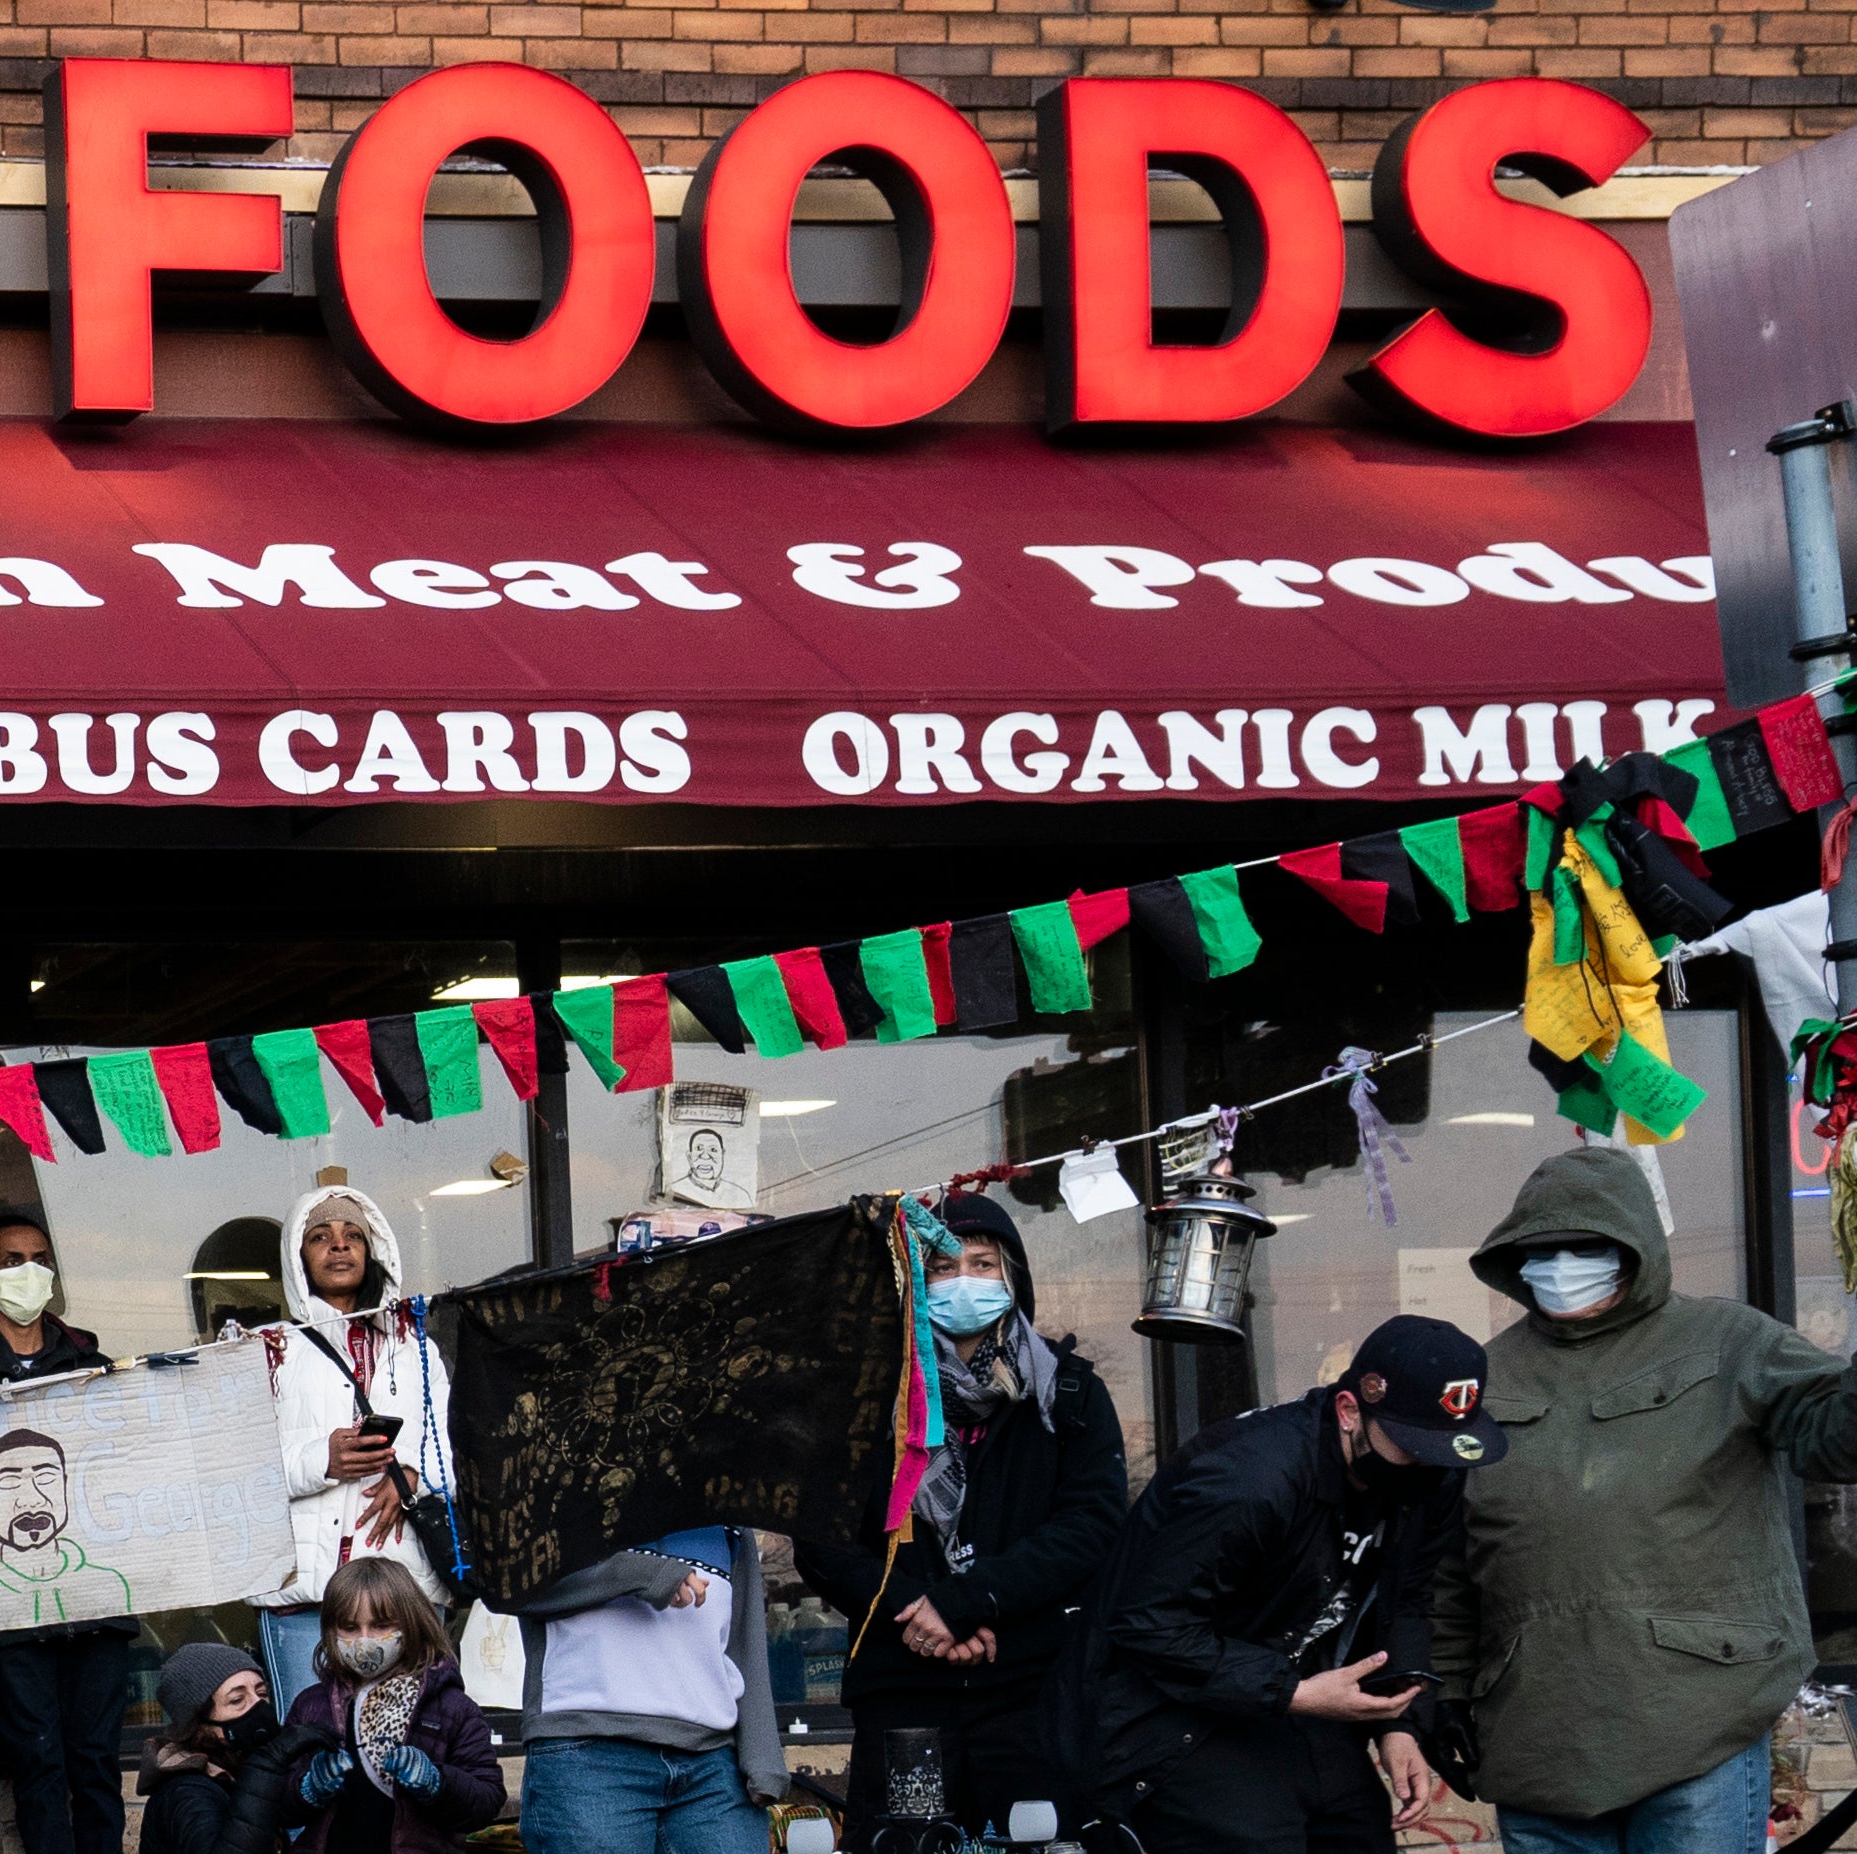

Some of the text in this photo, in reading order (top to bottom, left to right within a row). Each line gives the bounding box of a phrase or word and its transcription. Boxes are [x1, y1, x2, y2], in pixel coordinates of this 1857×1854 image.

[60, 56, 1655, 438] FOODS
[132, 542, 743, 611] Meat
[787, 541, 963, 610] &
[1024, 541, 1717, 610] Produ
[259, 709, 691, 795] CARDS
[802, 706, 1380, 796] ORGANIC
[1413, 699, 1715, 786] MILK
[147, 1368, 264, 1430] for
[72, 1442, 289, 1570] George
[946, 1543, 974, 1561] RESS
